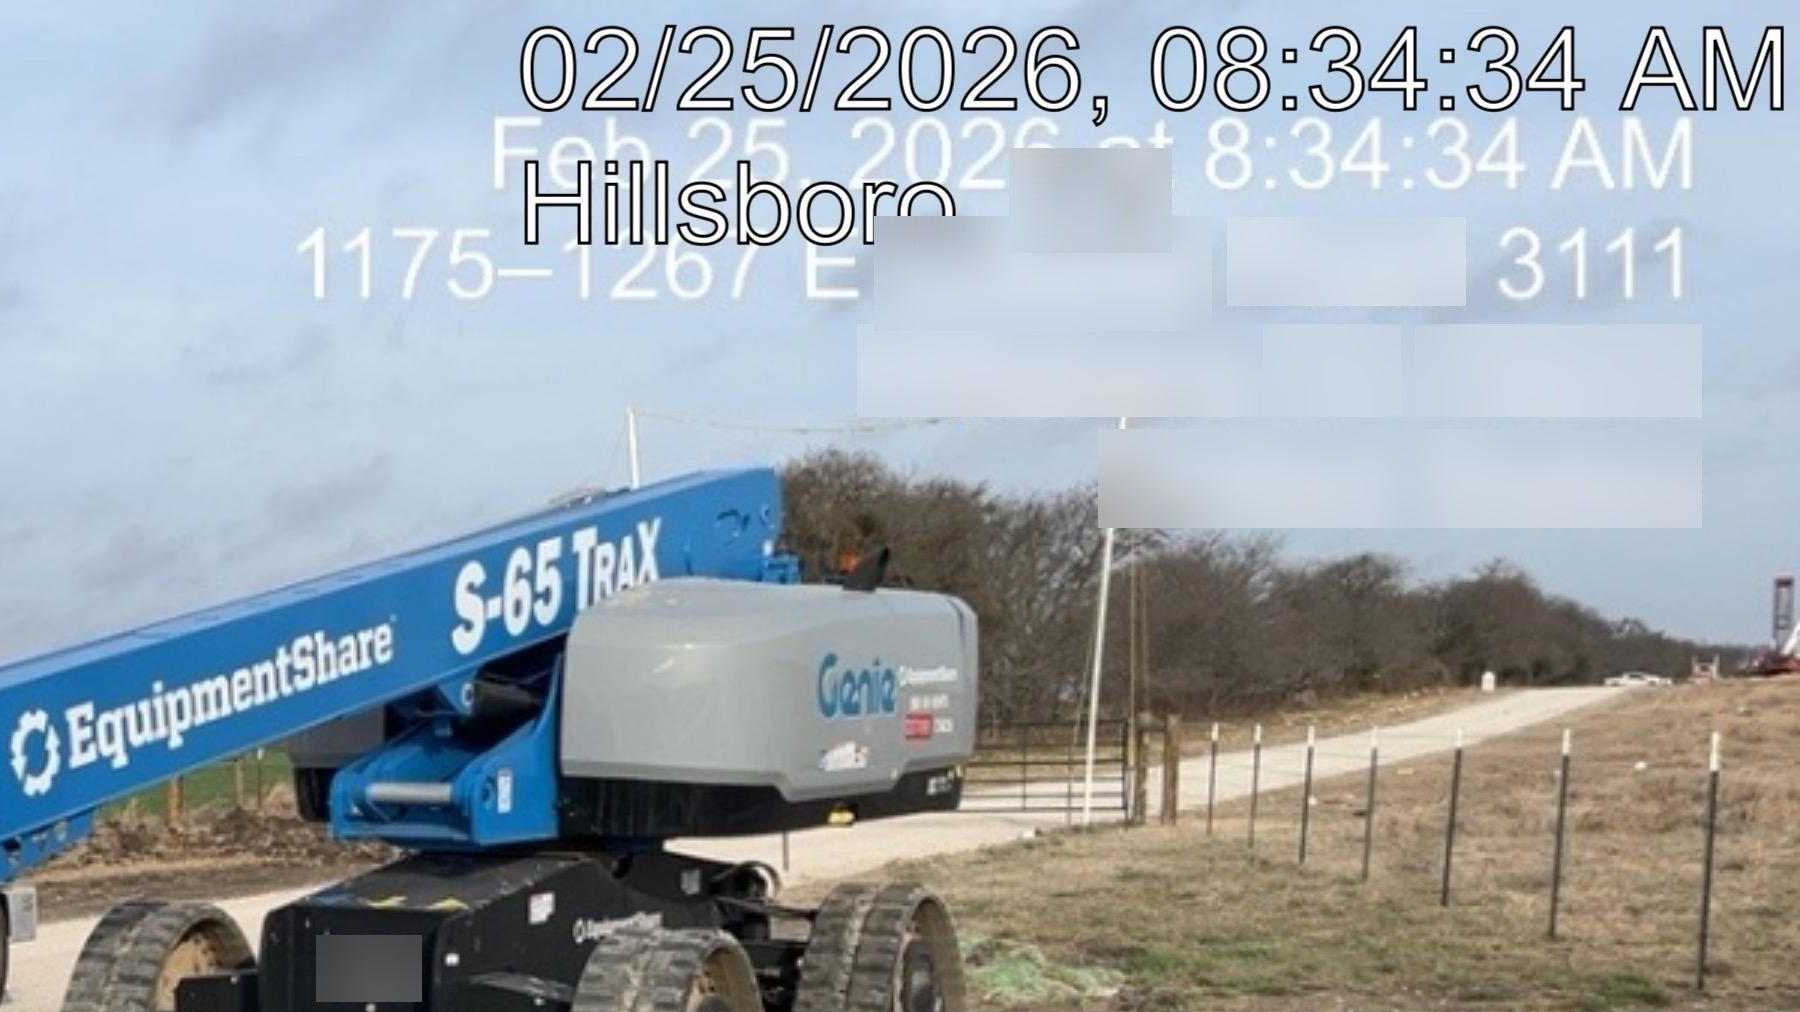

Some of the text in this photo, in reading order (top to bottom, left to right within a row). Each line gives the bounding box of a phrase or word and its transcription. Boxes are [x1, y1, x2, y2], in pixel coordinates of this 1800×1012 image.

[452, 547, 563, 655] S-65
[64, 620, 395, 770] EquipmentShare
[818, 652, 896, 719] Genie
